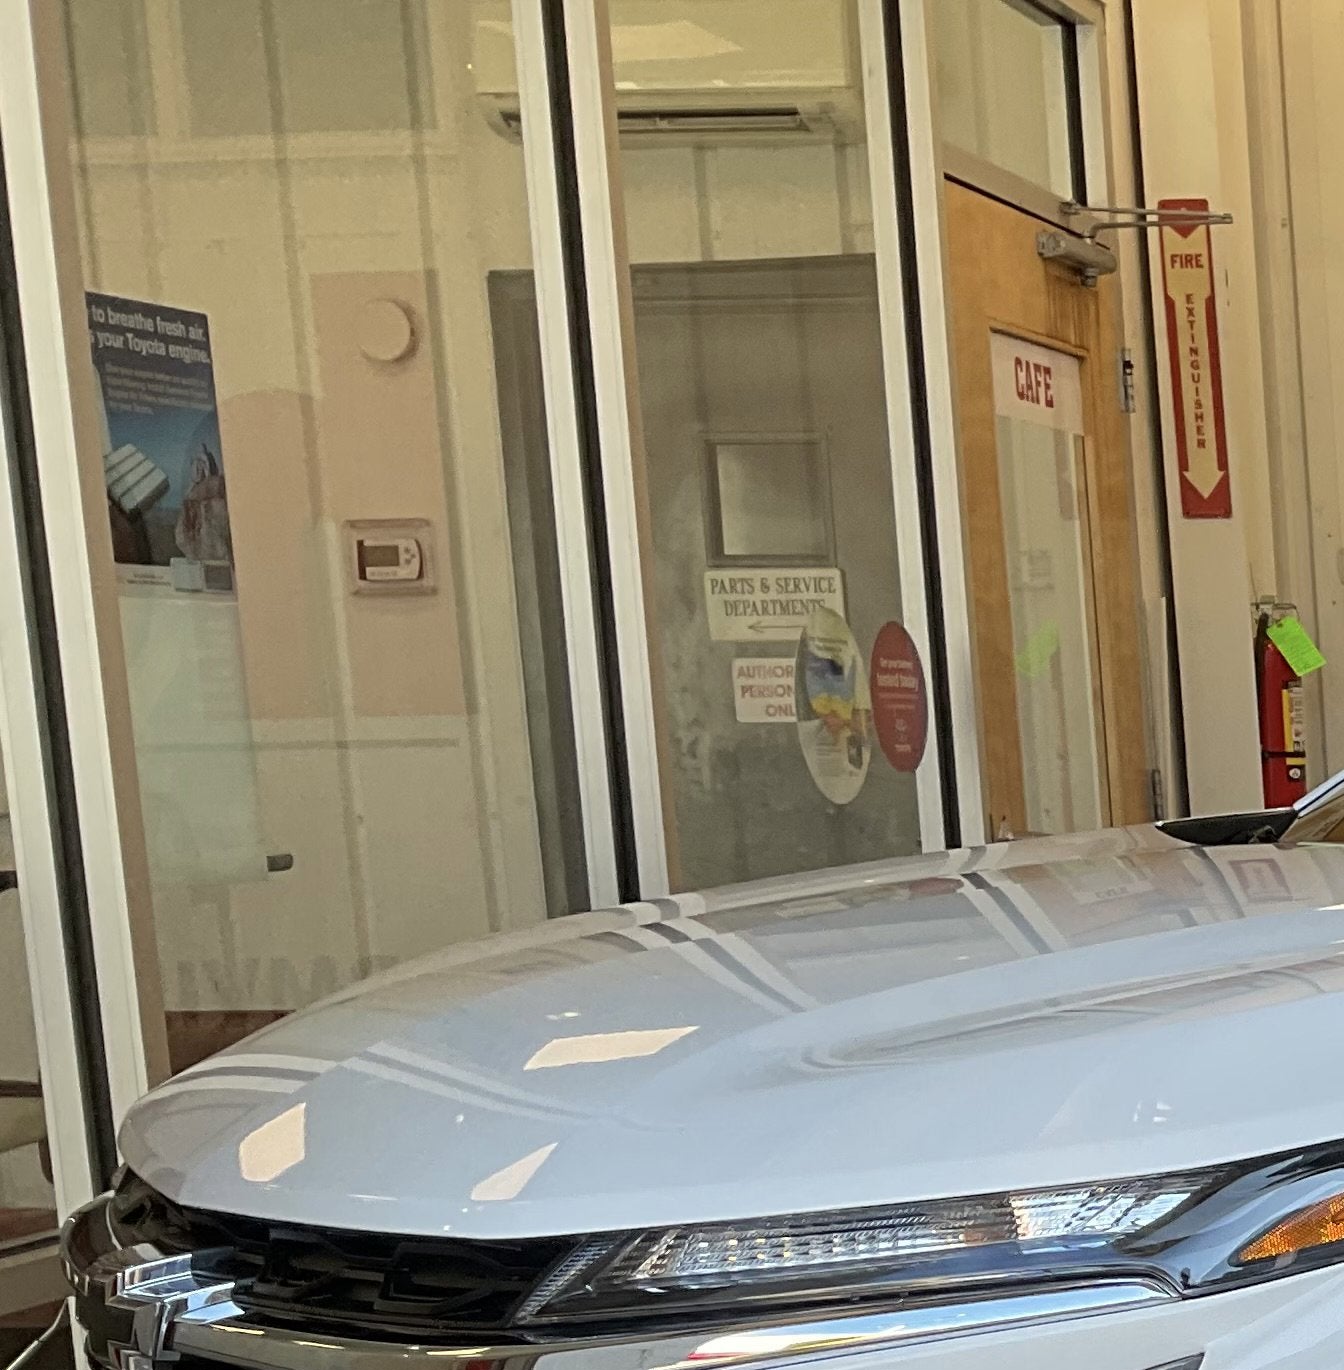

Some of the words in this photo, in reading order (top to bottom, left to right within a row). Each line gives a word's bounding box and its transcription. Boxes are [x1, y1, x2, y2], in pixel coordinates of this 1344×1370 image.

[1170, 253, 1204, 269] FIRE
[92, 305, 105, 323] to
[107, 306, 154, 333] breathe
[156, 316, 187, 338] fresh
[188, 323, 207, 341] air.
[96, 332, 124, 349] your
[125, 333, 166, 356] Toyota
[168, 344, 211, 364] engine.
[1014, 356, 1054, 408] CAFE
[1185, 293, 1206, 449] EXTINGUISHER
[711, 578, 755, 595] PARTS
[760, 577, 770, 594] &
[775, 576, 836, 594] SERVICE
